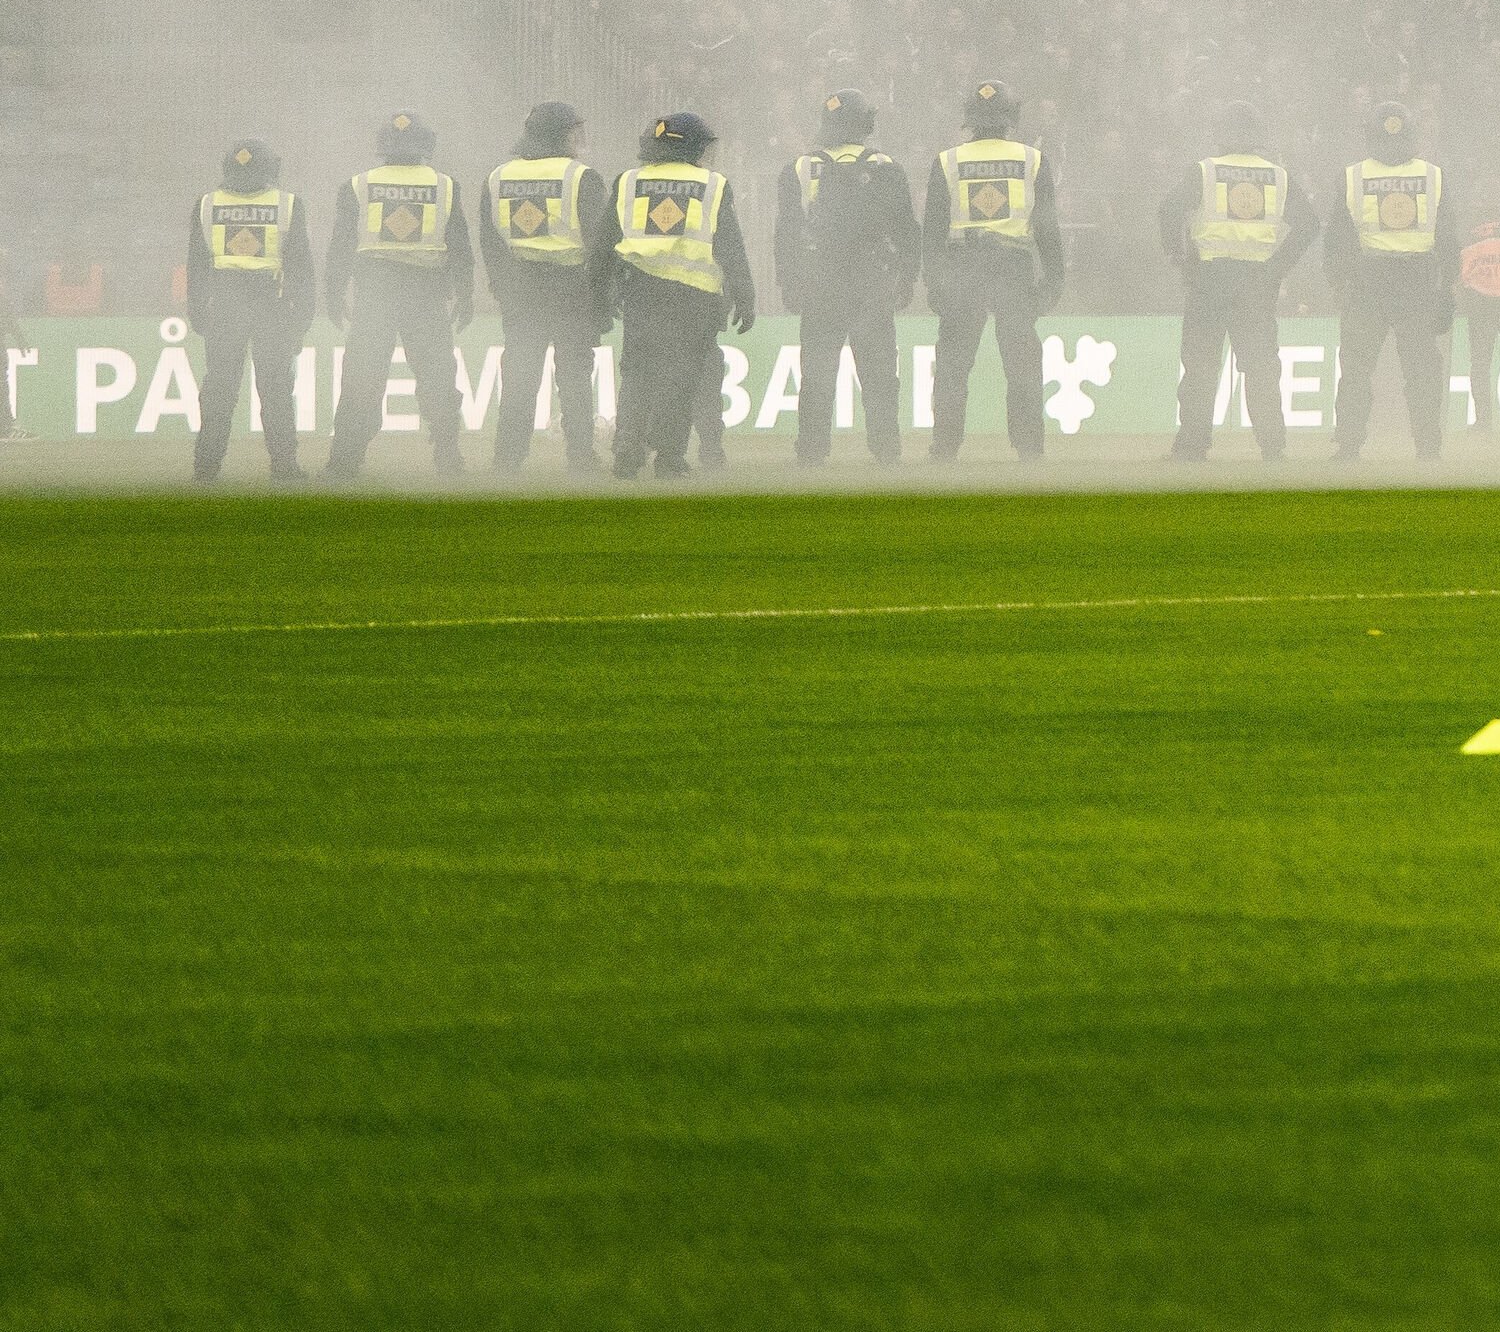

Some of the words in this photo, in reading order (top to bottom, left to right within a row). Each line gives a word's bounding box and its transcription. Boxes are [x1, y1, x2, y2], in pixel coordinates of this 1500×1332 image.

[372, 186, 433, 202] POLITI
[1367, 178, 1423, 194] POLITI
[217, 207, 276, 223] POLITI
[76, 317, 202, 434] PÅ
